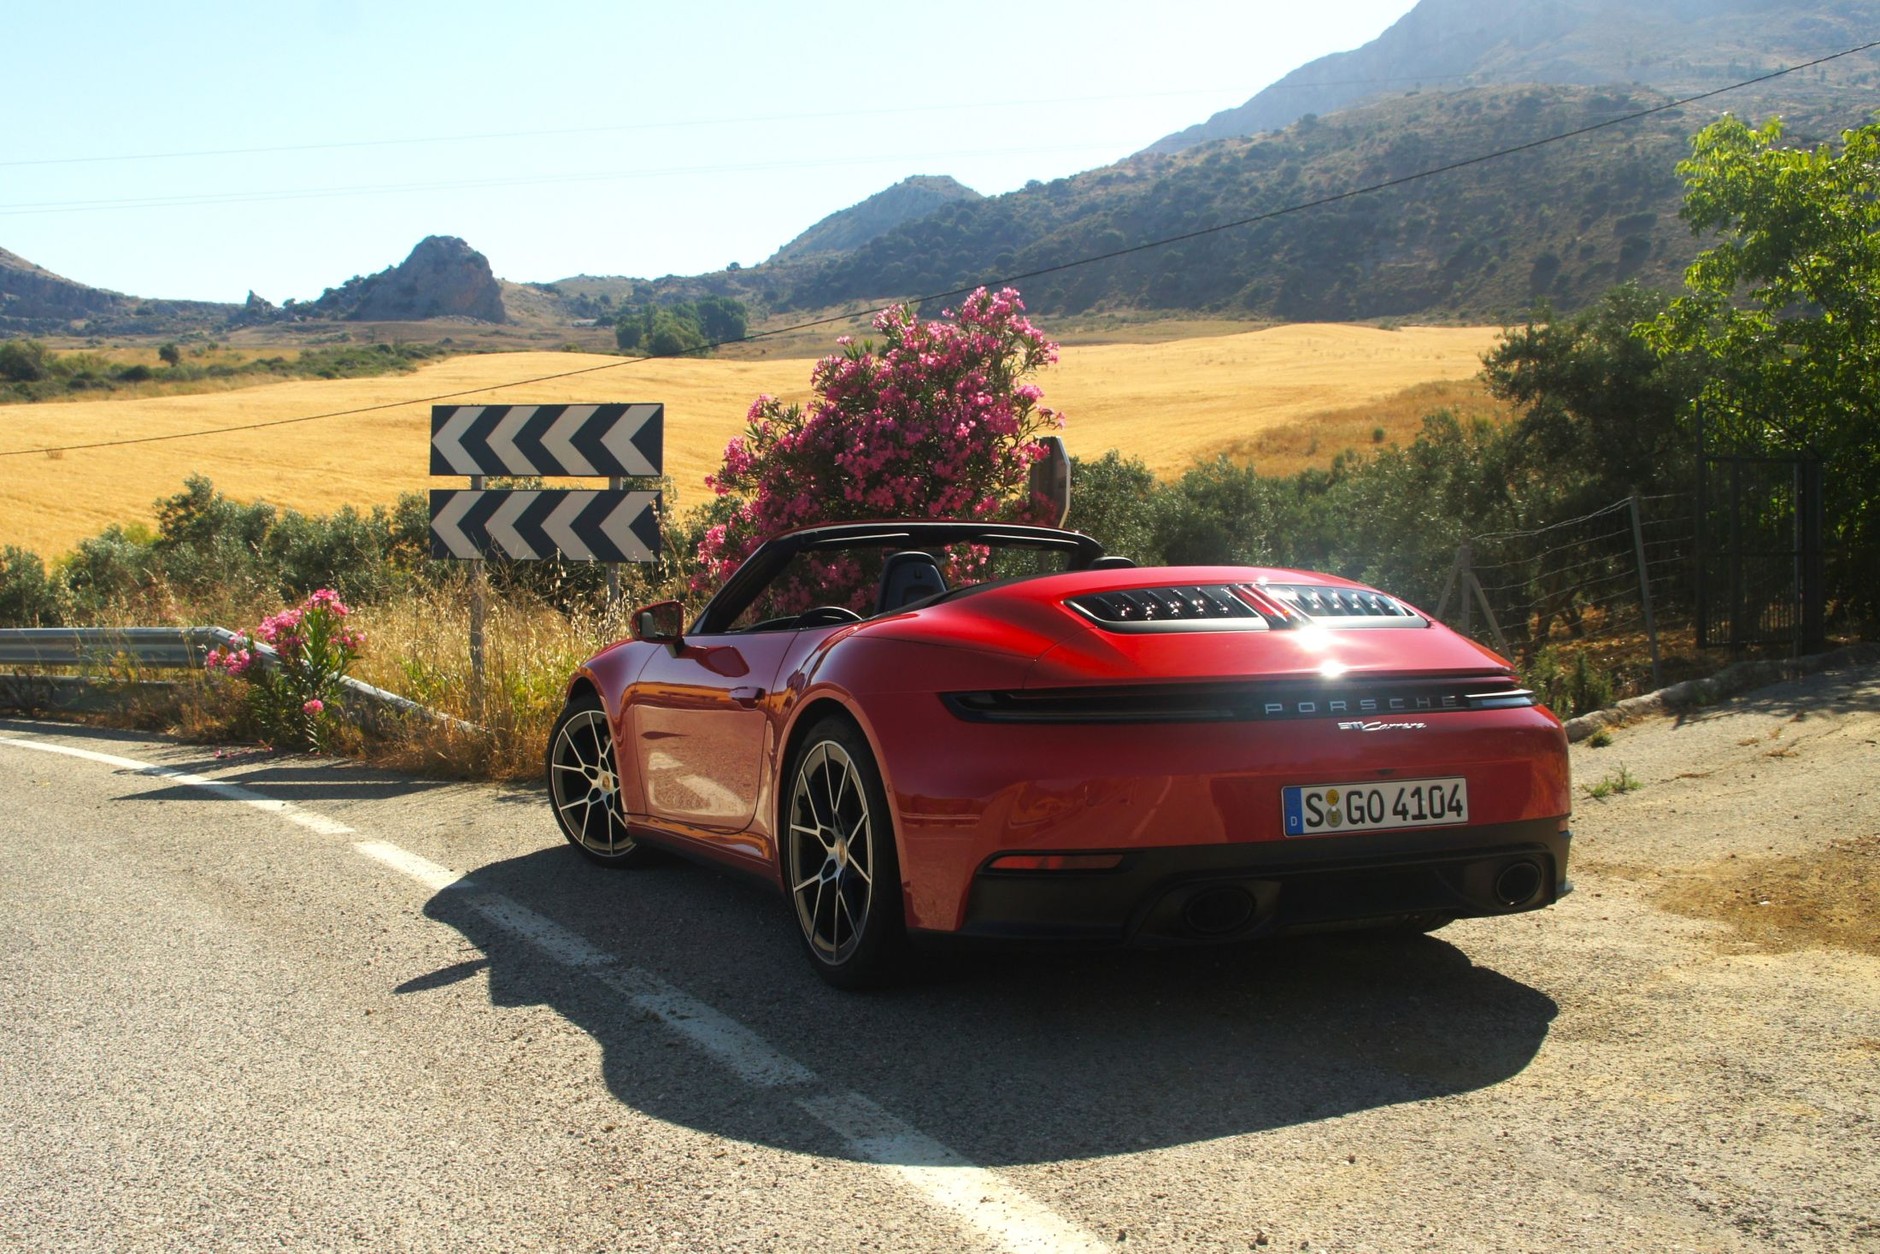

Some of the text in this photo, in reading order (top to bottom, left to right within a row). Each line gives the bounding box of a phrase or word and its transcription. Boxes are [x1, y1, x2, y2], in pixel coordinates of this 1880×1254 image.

[1265, 696, 1456, 714] PORSCHE
[1362, 721, 1427, 732] Carrera
[1305, 792, 1325, 828] S
[1392, 783, 1463, 821] 4104
[1290, 816, 1298, 827] D
